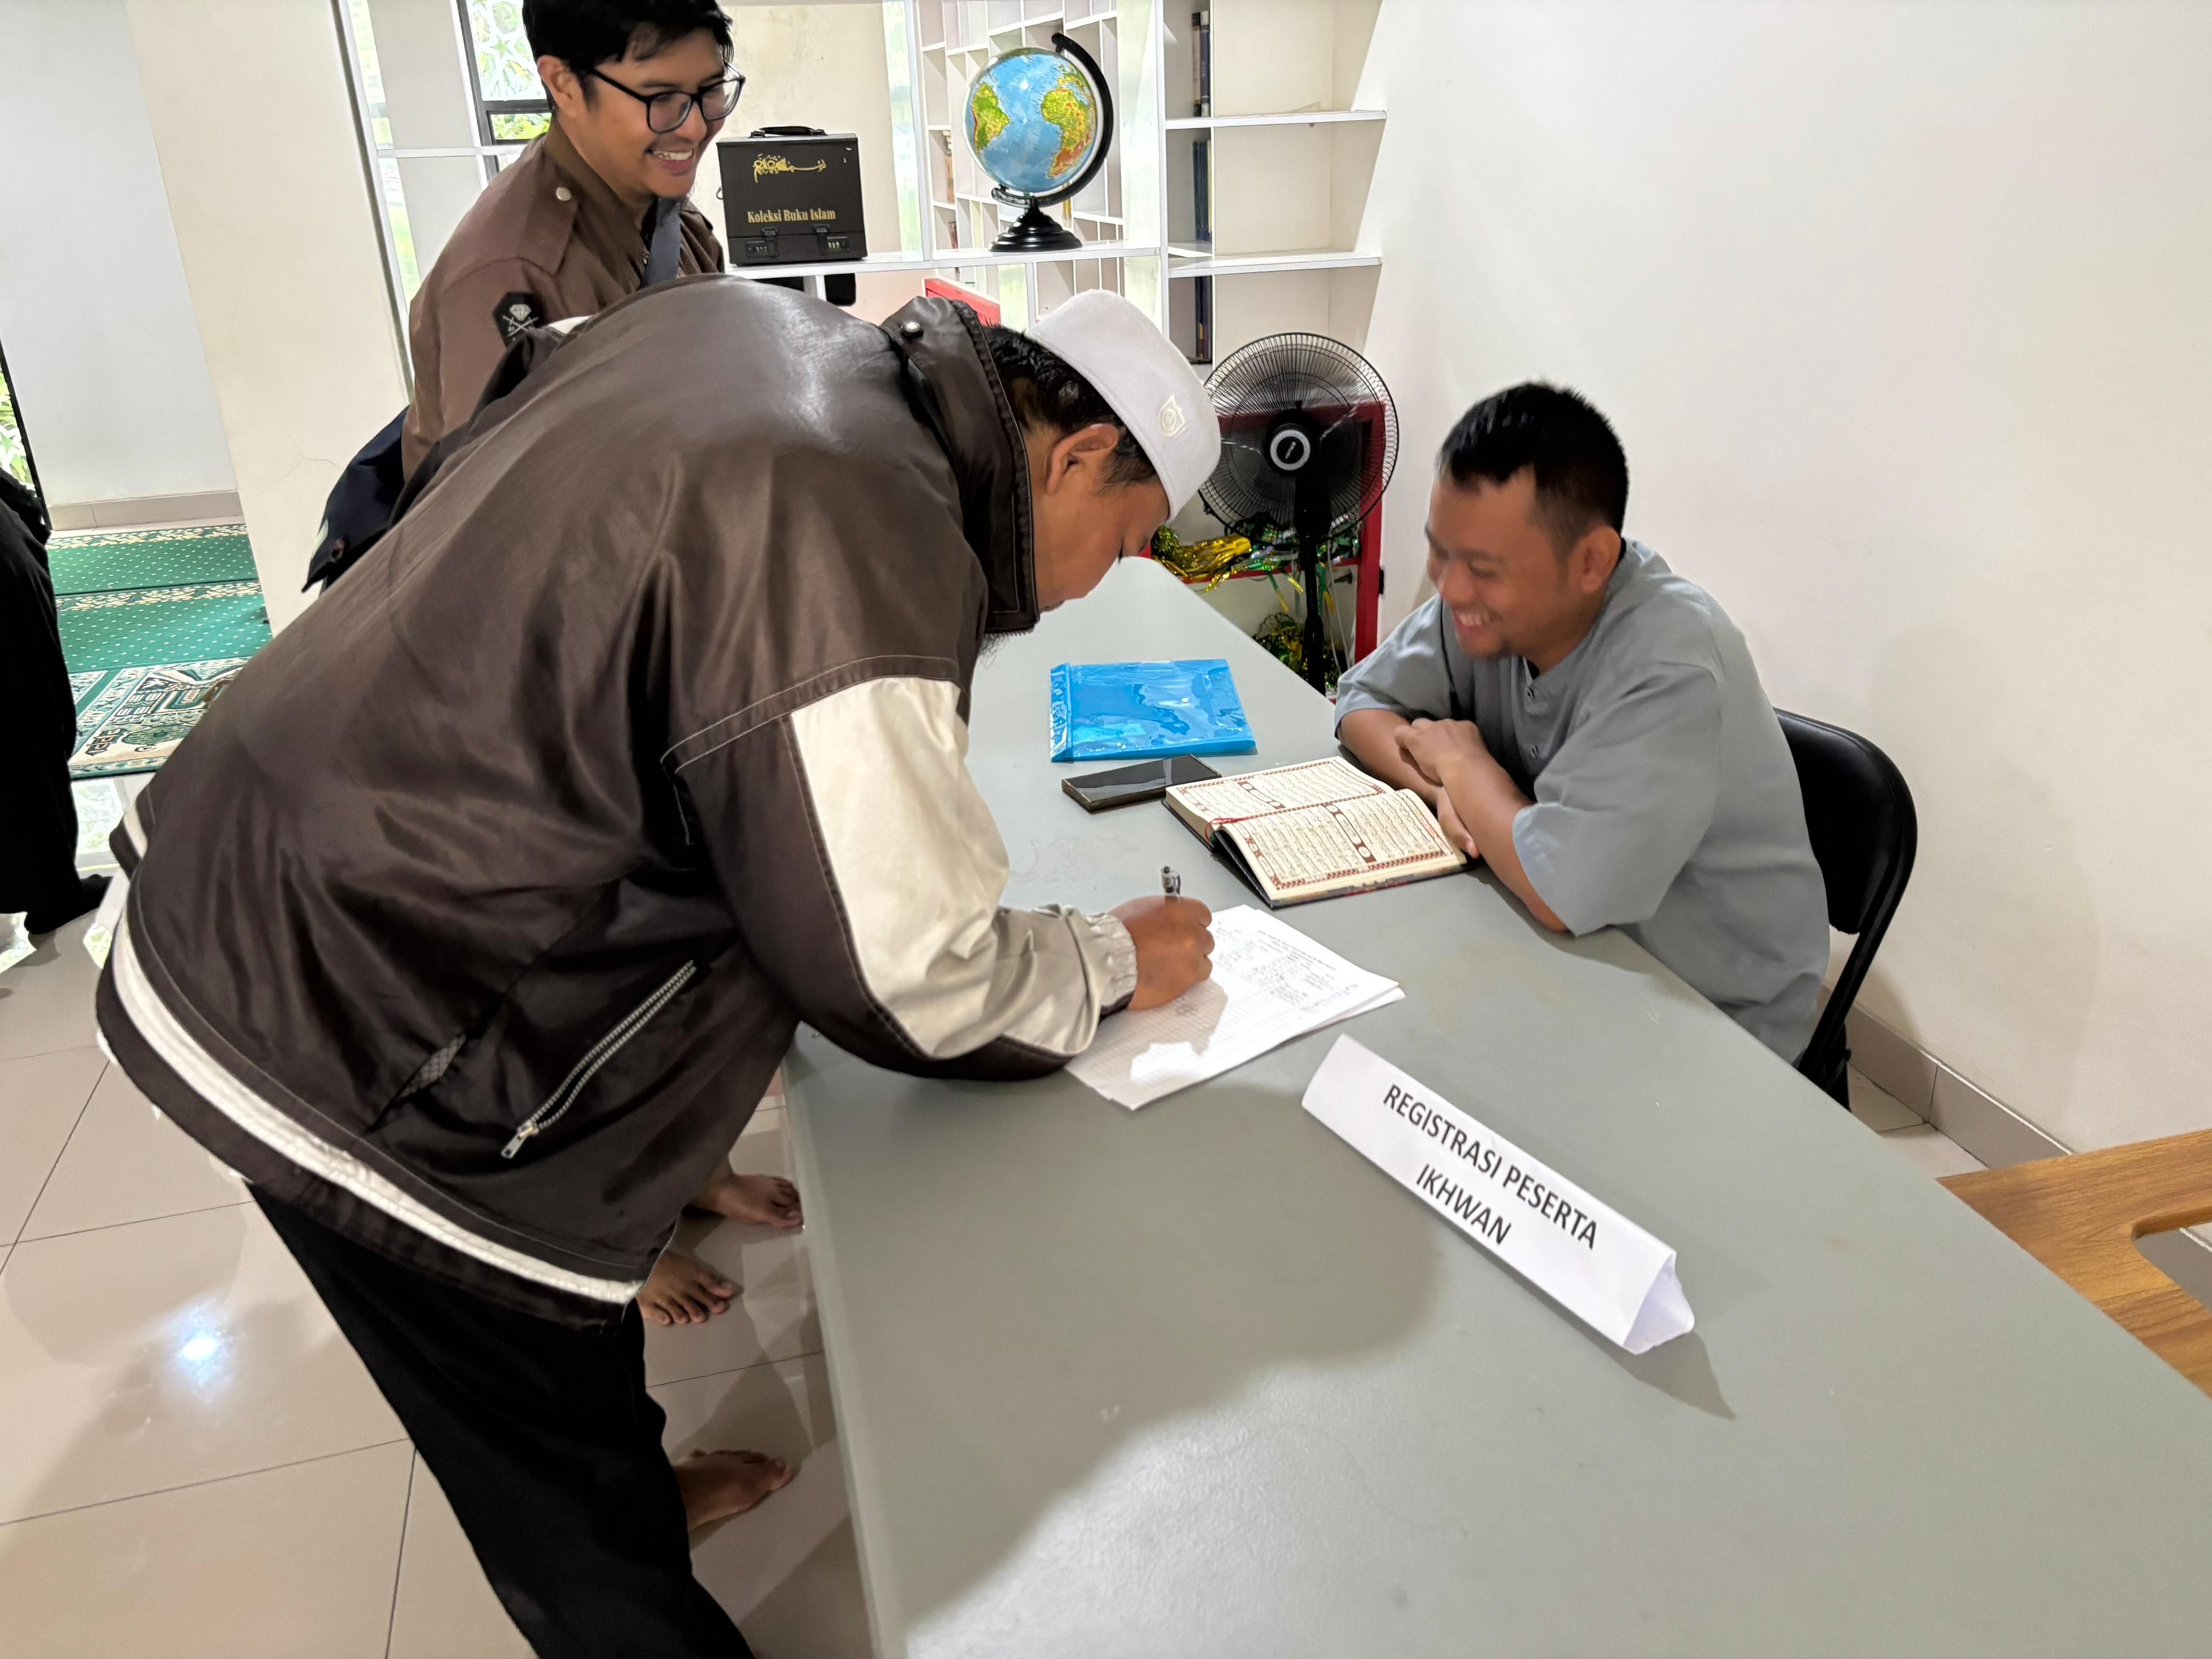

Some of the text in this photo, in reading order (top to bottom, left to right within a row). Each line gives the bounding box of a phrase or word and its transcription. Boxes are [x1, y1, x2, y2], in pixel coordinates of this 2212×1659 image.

[748, 208, 836, 223] Koleksi Buku Islam
[1384, 1084, 1597, 1250] REGISTRASI PESERTA
[1417, 1163, 1512, 1245] IKHWAN
